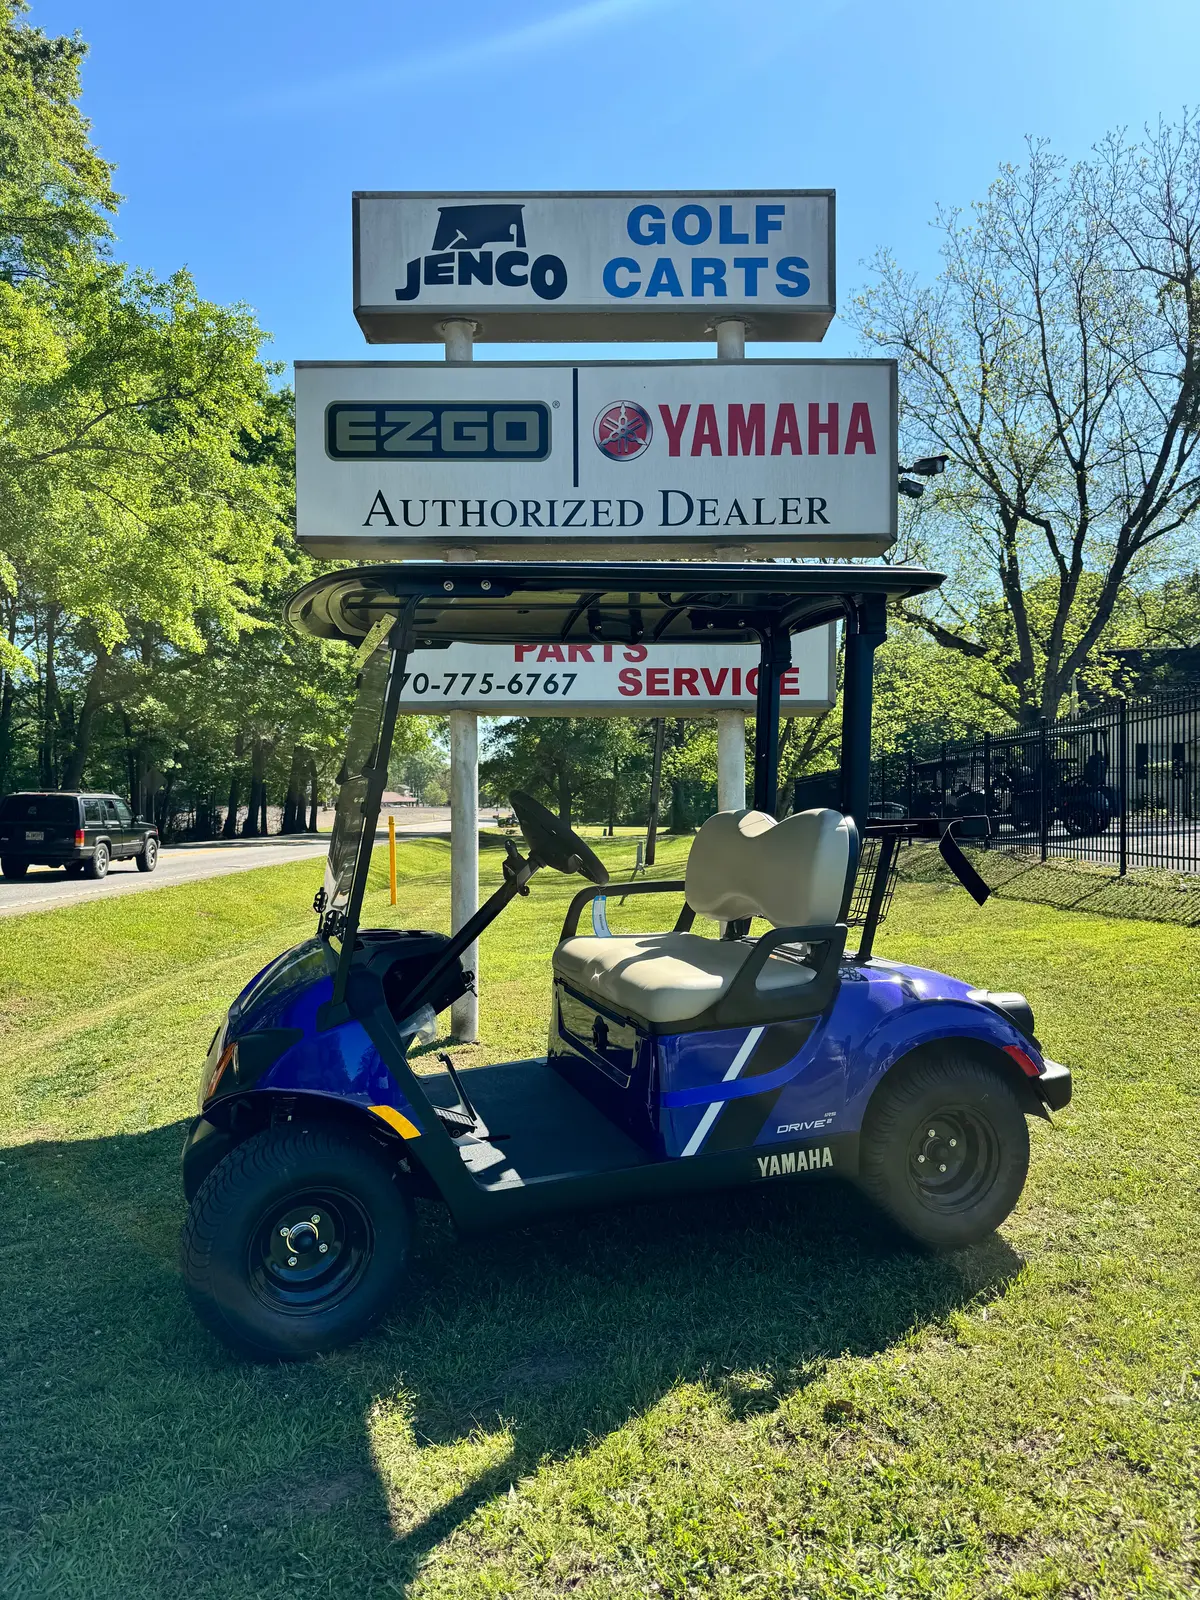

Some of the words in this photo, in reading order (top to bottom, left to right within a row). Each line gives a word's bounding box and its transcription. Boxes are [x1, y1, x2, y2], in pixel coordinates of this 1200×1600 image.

[626, 204, 786, 245] GOLF
[394, 250, 568, 301] JENCO
[602, 256, 811, 298] CARTS
[658, 402, 877, 457] YAMAHA
[361, 489, 644, 527] AUTHORIZED
[657, 489, 832, 527] DEALER
[388, 672, 578, 696] 70-775-6767
[757, 1147, 833, 1177] YAMAHA
